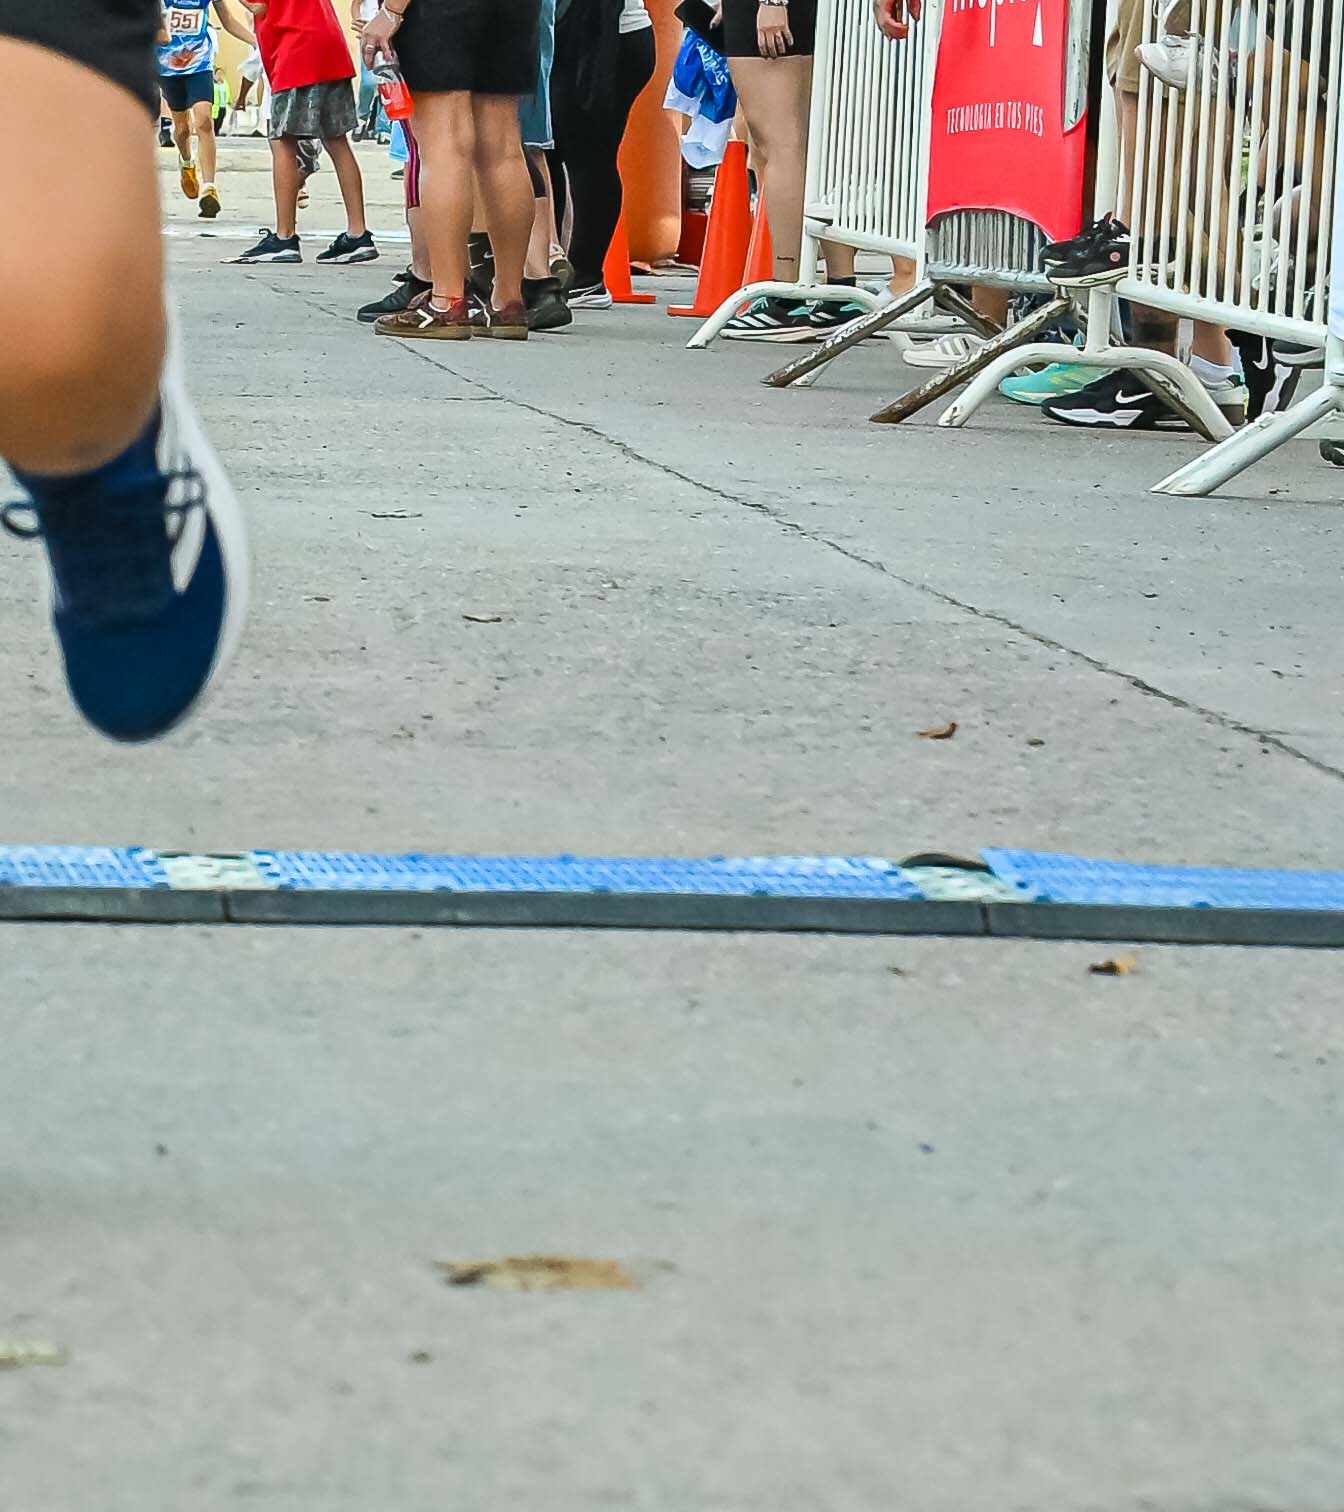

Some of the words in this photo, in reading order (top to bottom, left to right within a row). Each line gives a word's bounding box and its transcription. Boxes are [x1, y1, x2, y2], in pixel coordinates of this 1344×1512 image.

[172, 12, 199, 29] 551
[995, 102, 1004, 129] EN
[1007, 101, 1022, 129] TUS
[1025, 103, 1044, 137] PIES
